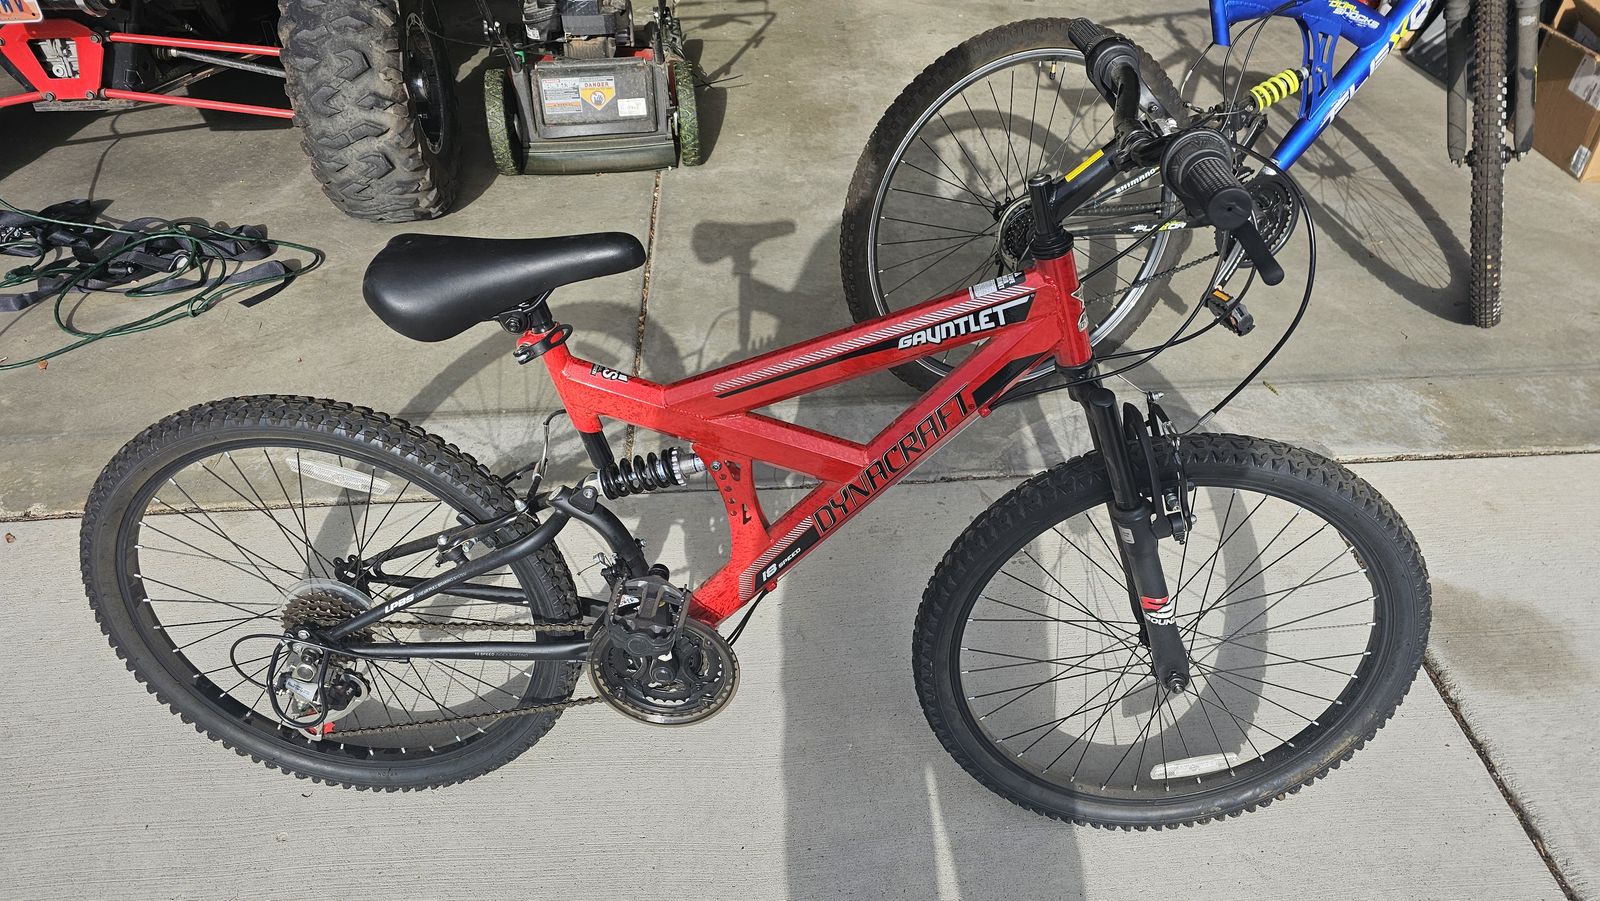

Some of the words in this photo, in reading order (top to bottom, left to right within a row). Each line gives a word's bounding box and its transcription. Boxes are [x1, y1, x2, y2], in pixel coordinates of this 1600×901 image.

[1333, 7, 1380, 29] SHOCKS
[898, 295, 1030, 349] GAUNTLET
[812, 383, 968, 534] DYNACRAFT
[762, 563, 777, 582] 18
[778, 547, 801, 569] SPEED
[384, 593, 415, 613] LPBS
